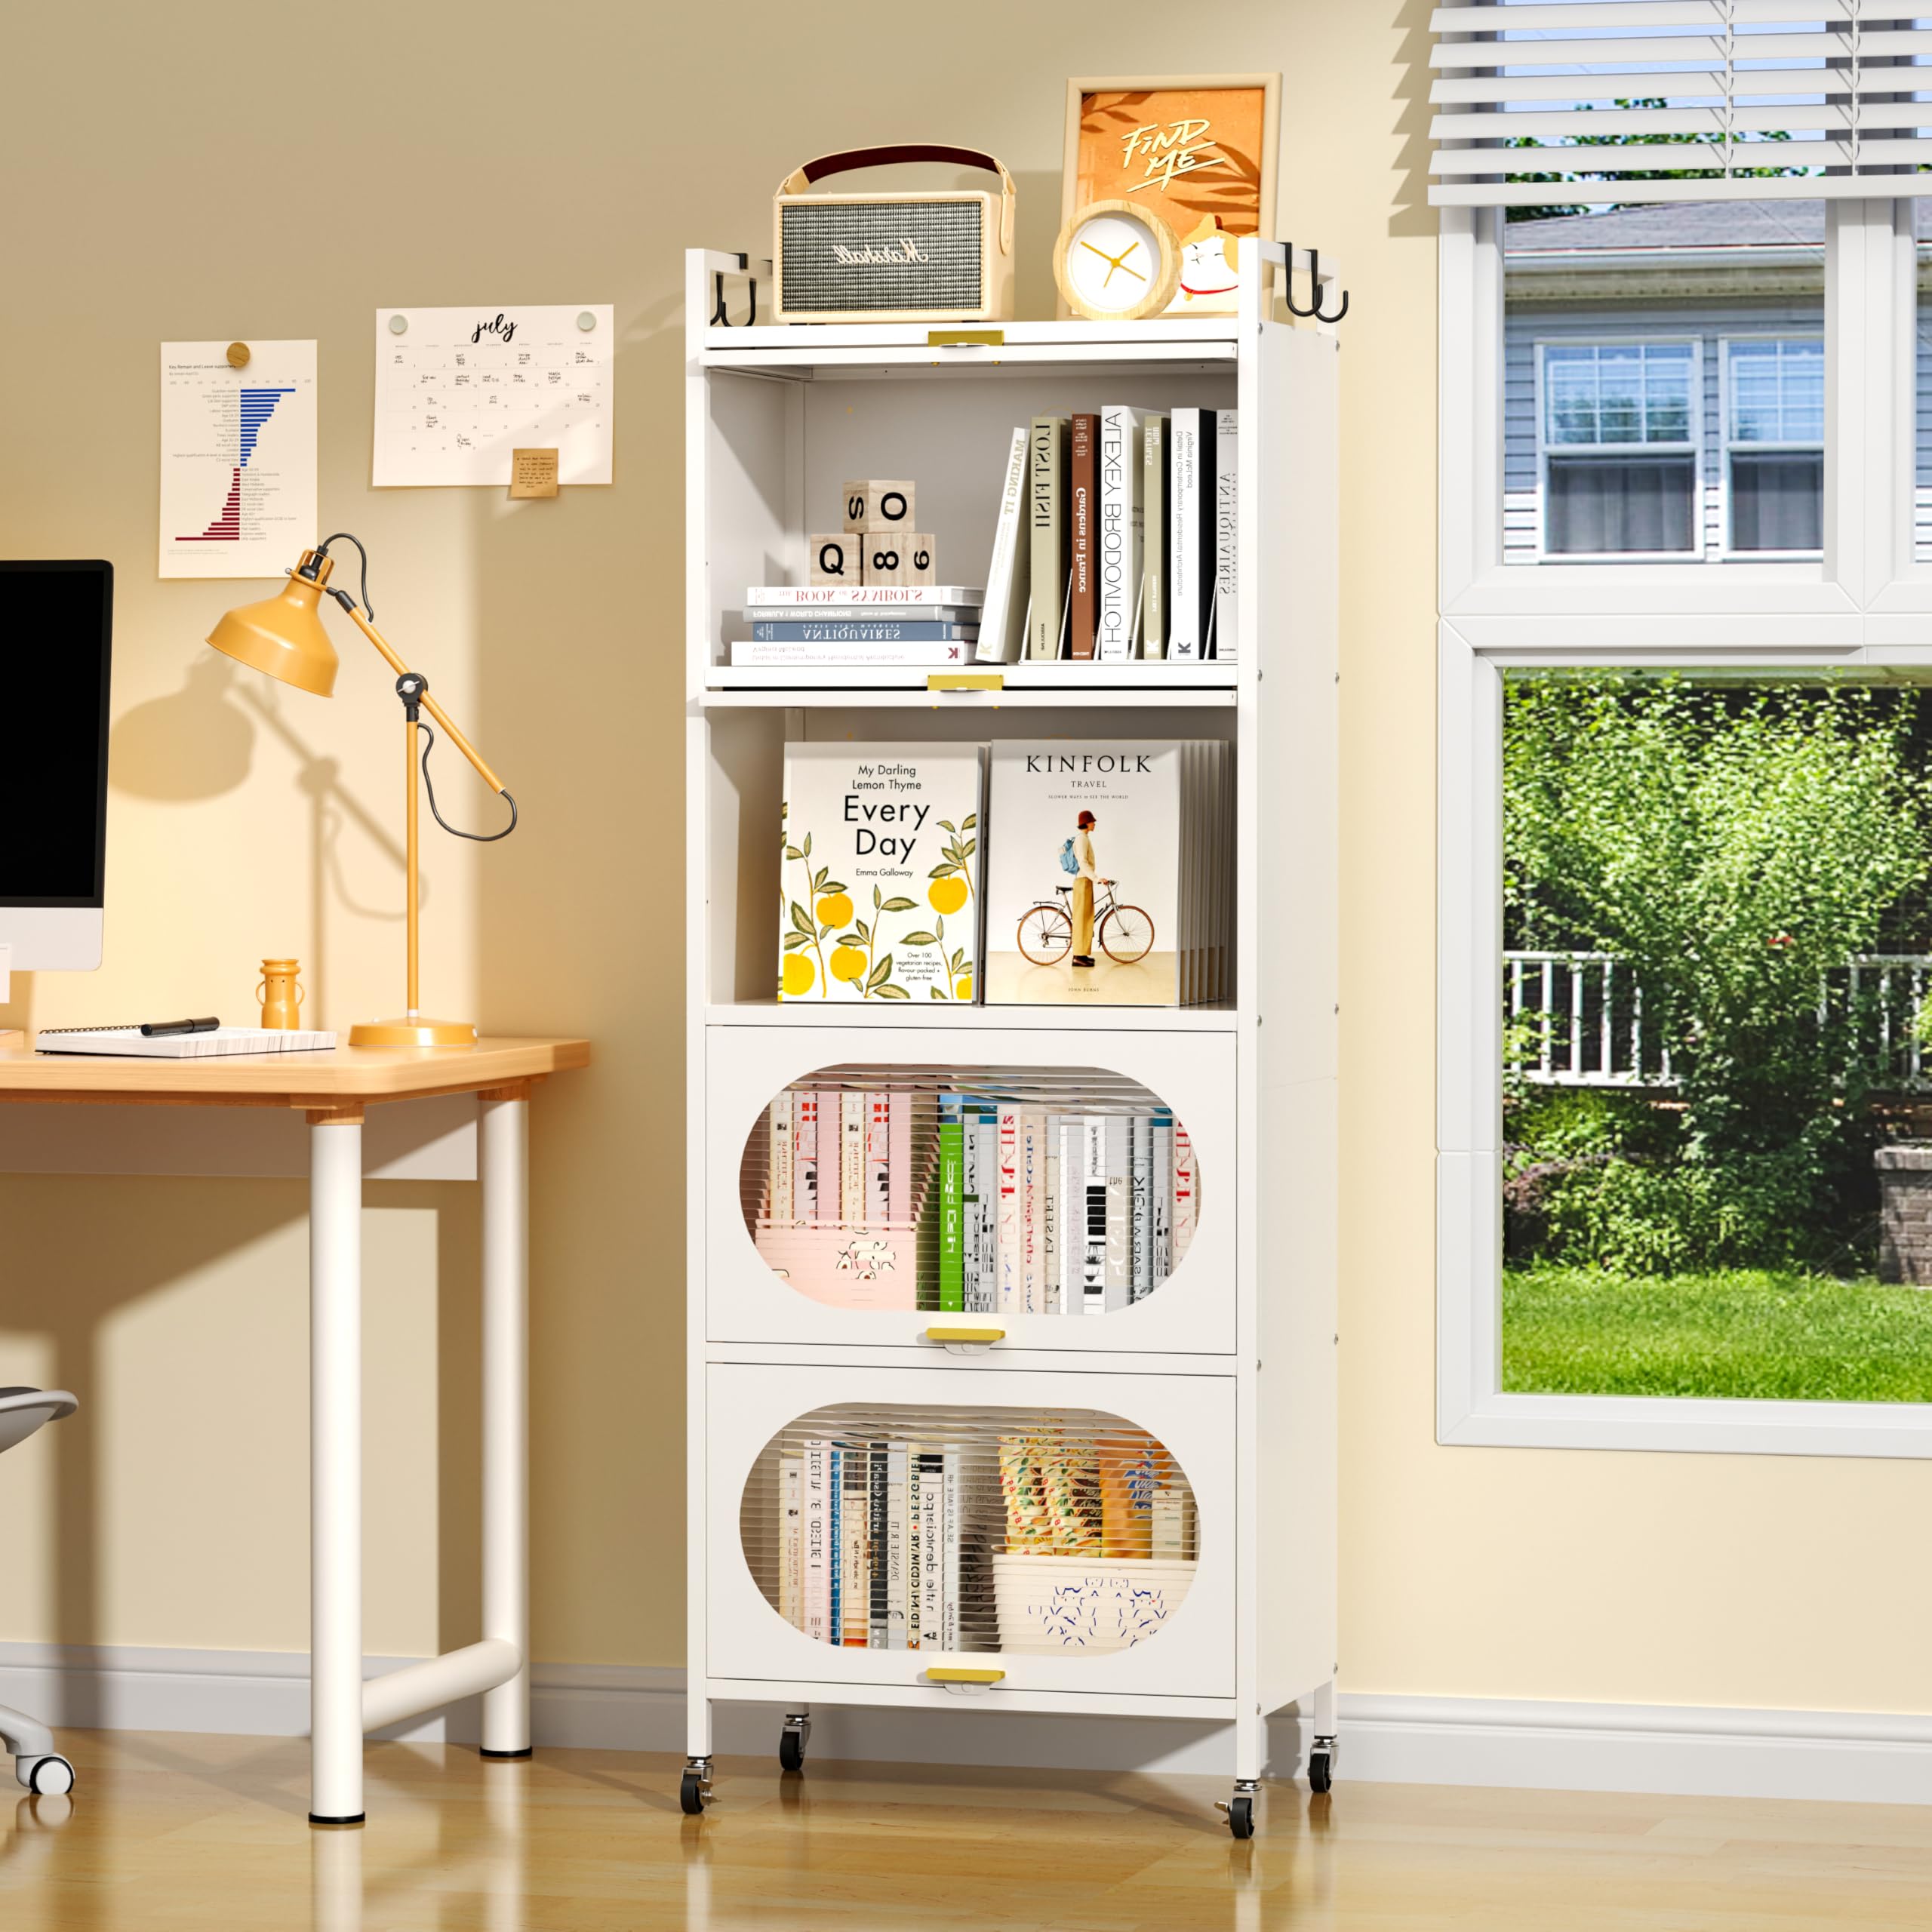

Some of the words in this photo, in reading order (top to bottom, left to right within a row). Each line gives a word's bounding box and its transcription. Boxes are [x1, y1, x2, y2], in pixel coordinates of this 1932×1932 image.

[1143, 141, 1217, 192] ME
[472, 314, 518, 343] july
[848, 496, 864, 520] S
[881, 492, 907, 521] O
[819, 543, 844, 576] Q
[873, 551, 899, 571] 8
[858, 764, 874, 778] My
[878, 764, 916, 778] Darling
[1026, 755, 1152, 773] KINFOLK
[852, 780, 884, 789] Lemon
[888, 779, 921, 792] Thyme
[844, 795, 931, 831] Every
[856, 829, 916, 864] Day
[879, 868, 913, 878] Galloway
